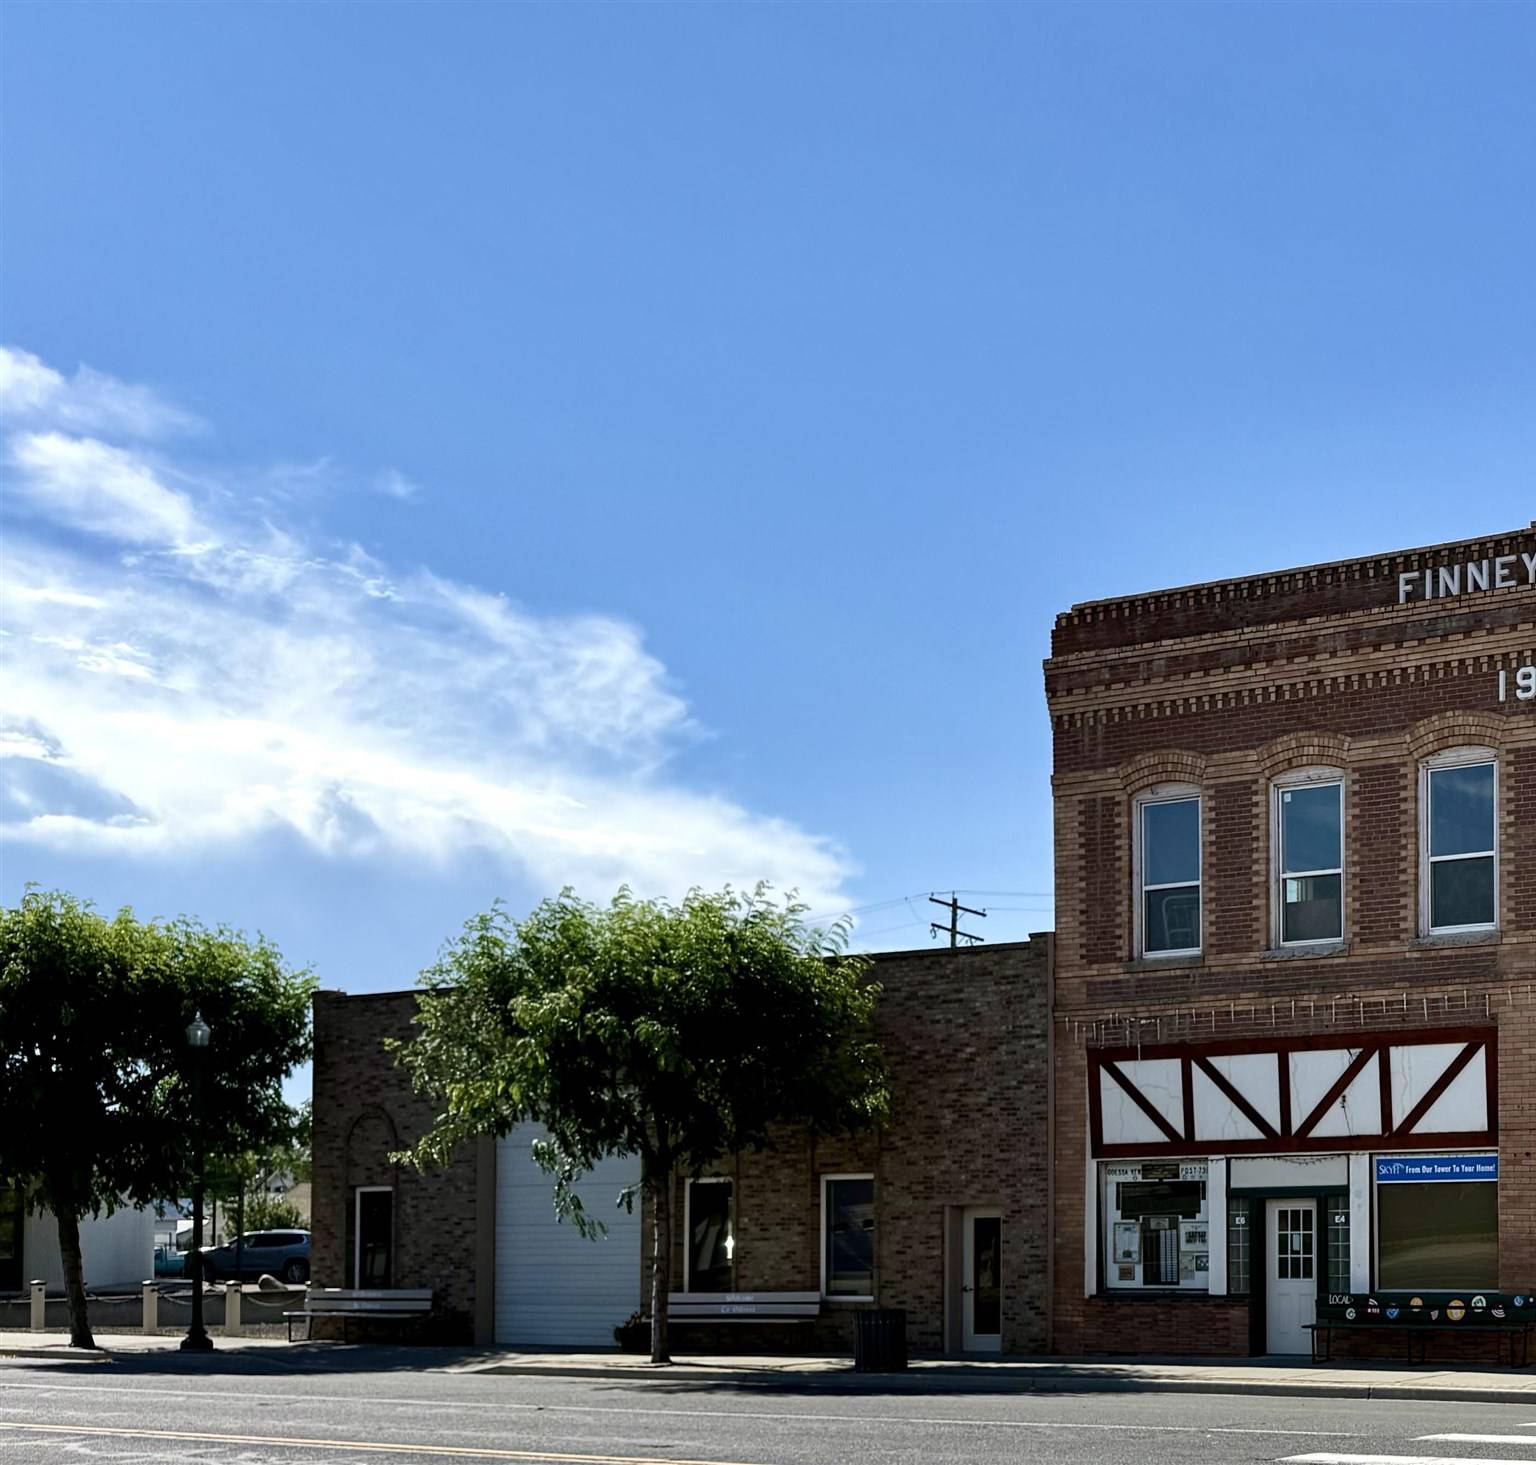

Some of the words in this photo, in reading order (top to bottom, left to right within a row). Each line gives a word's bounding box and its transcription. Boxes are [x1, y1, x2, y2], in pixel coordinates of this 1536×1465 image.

[1405, 1165, 1420, 1174] From
[1422, 1165, 1432, 1174] Our
[1434, 1164, 1451, 1173] Tower
[1452, 1164, 1460, 1172] To
[1461, 1164, 1475, 1172] Your
[1476, 1163, 1496, 1172] Home!
[1235, 1216, 1246, 1225] E6
[1334, 1215, 1346, 1223] E4
